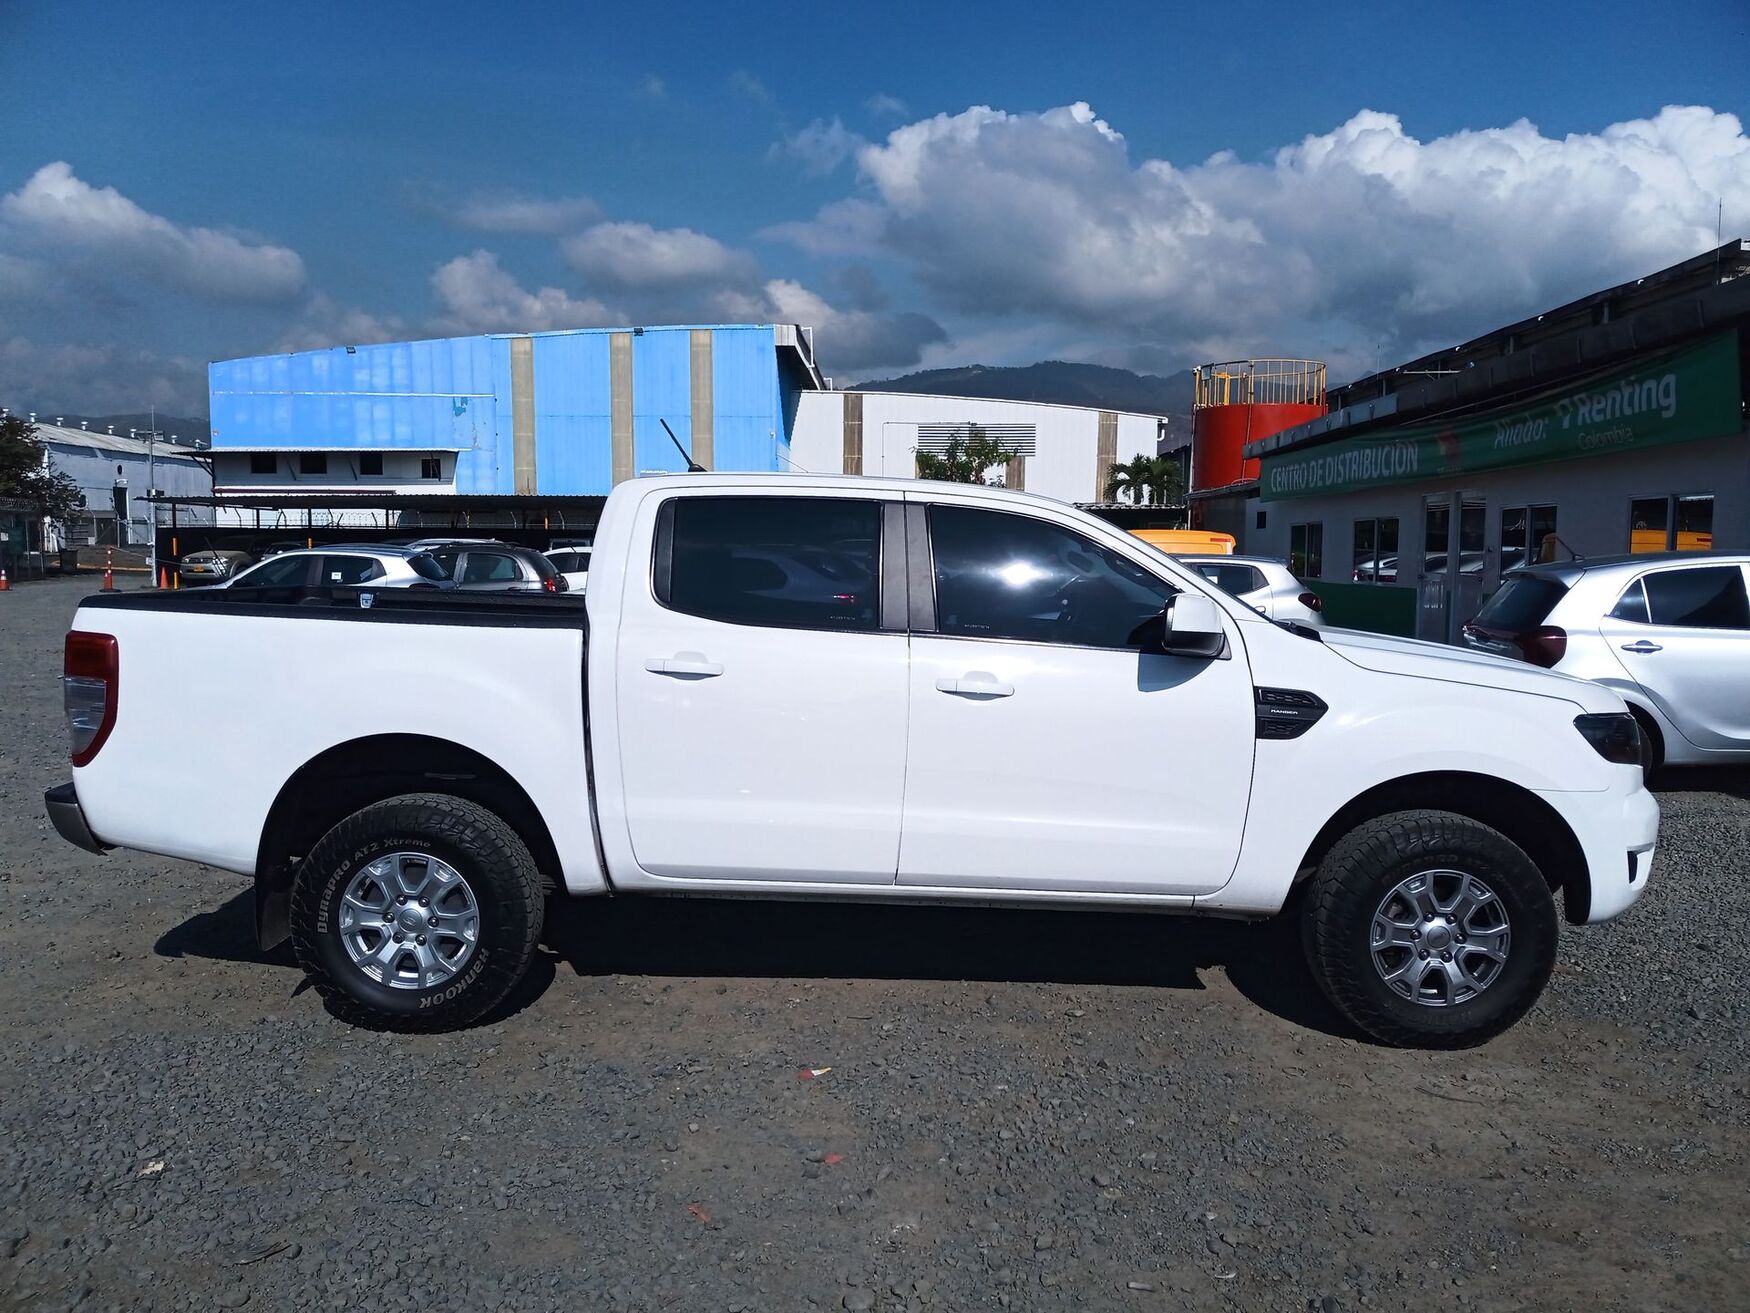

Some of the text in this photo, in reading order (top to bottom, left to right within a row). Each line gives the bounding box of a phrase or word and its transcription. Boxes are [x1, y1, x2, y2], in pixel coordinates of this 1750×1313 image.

[1577, 373, 1677, 426] Renting
[1577, 423, 1633, 450] Colombia
[1270, 463, 1307, 492] CENTRO
[1309, 459, 1324, 487] DE
